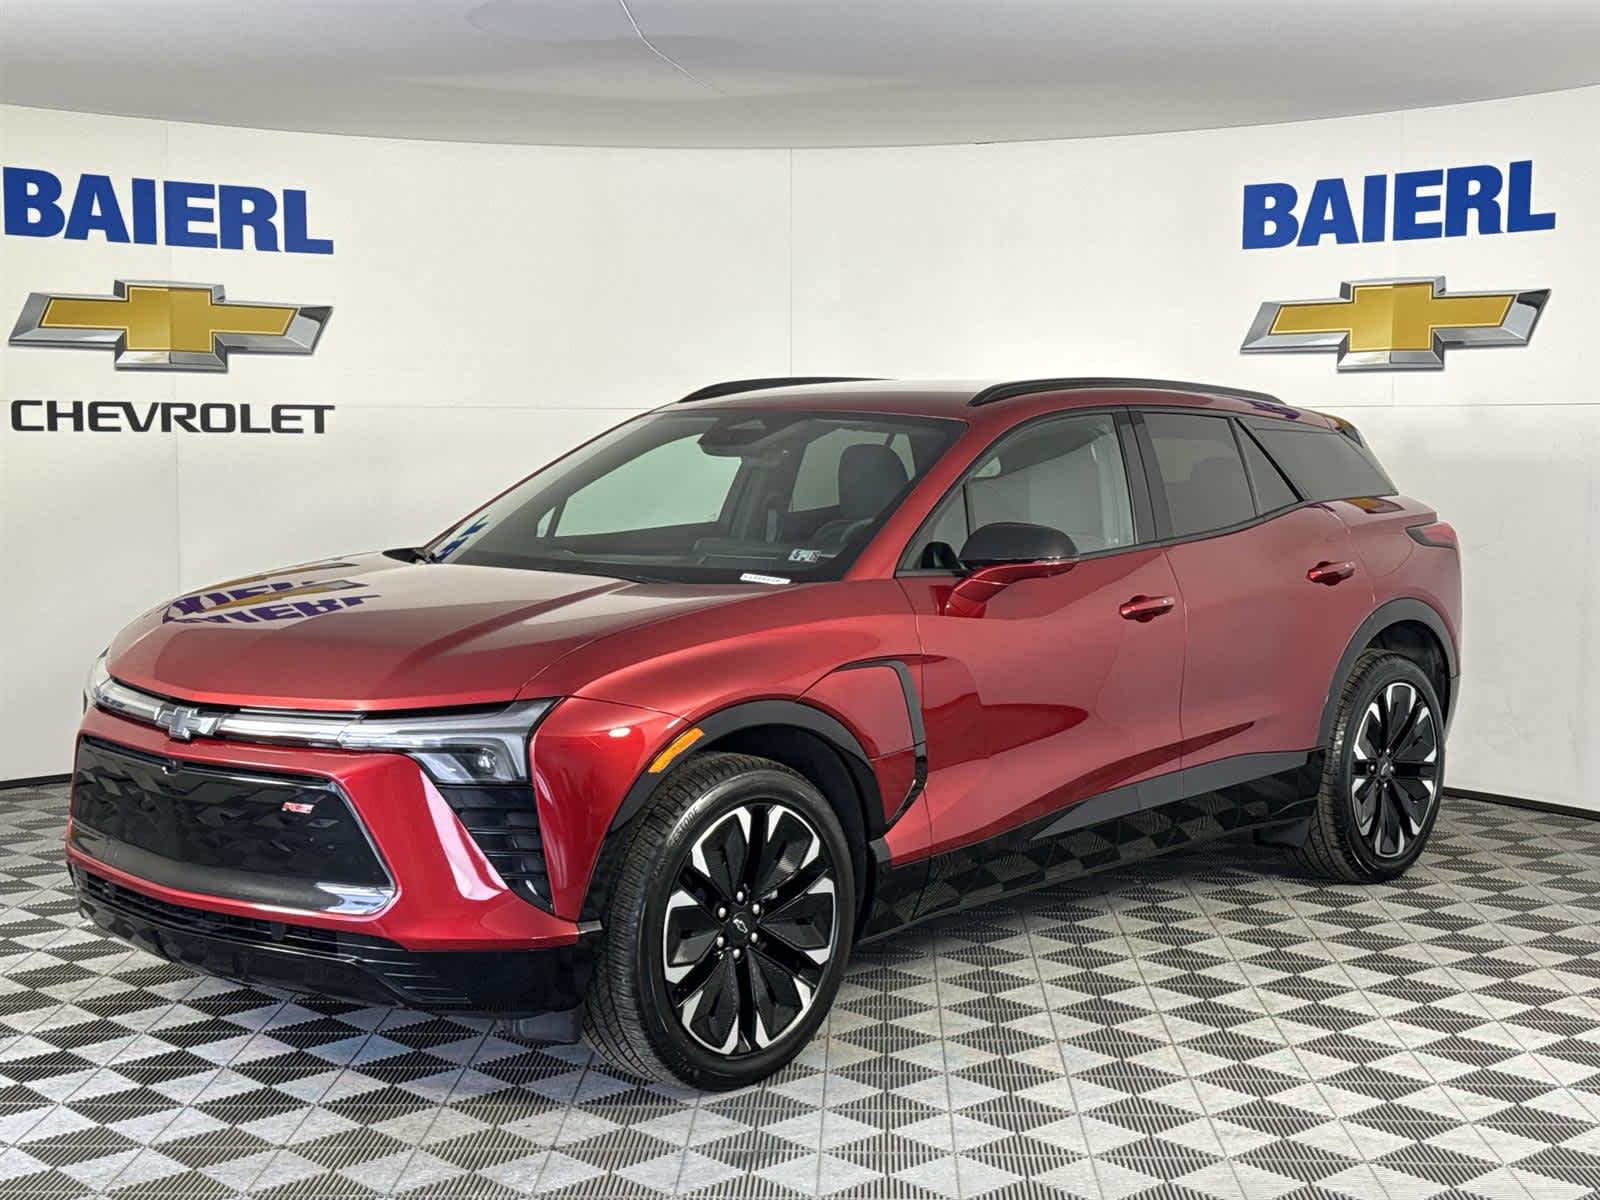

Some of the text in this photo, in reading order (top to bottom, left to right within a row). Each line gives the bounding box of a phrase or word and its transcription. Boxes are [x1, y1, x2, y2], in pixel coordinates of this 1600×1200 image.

[3, 166, 334, 255] BAIERL
[1242, 160, 1556, 250] BAIERL
[10, 399, 336, 434] CHEVROLET
